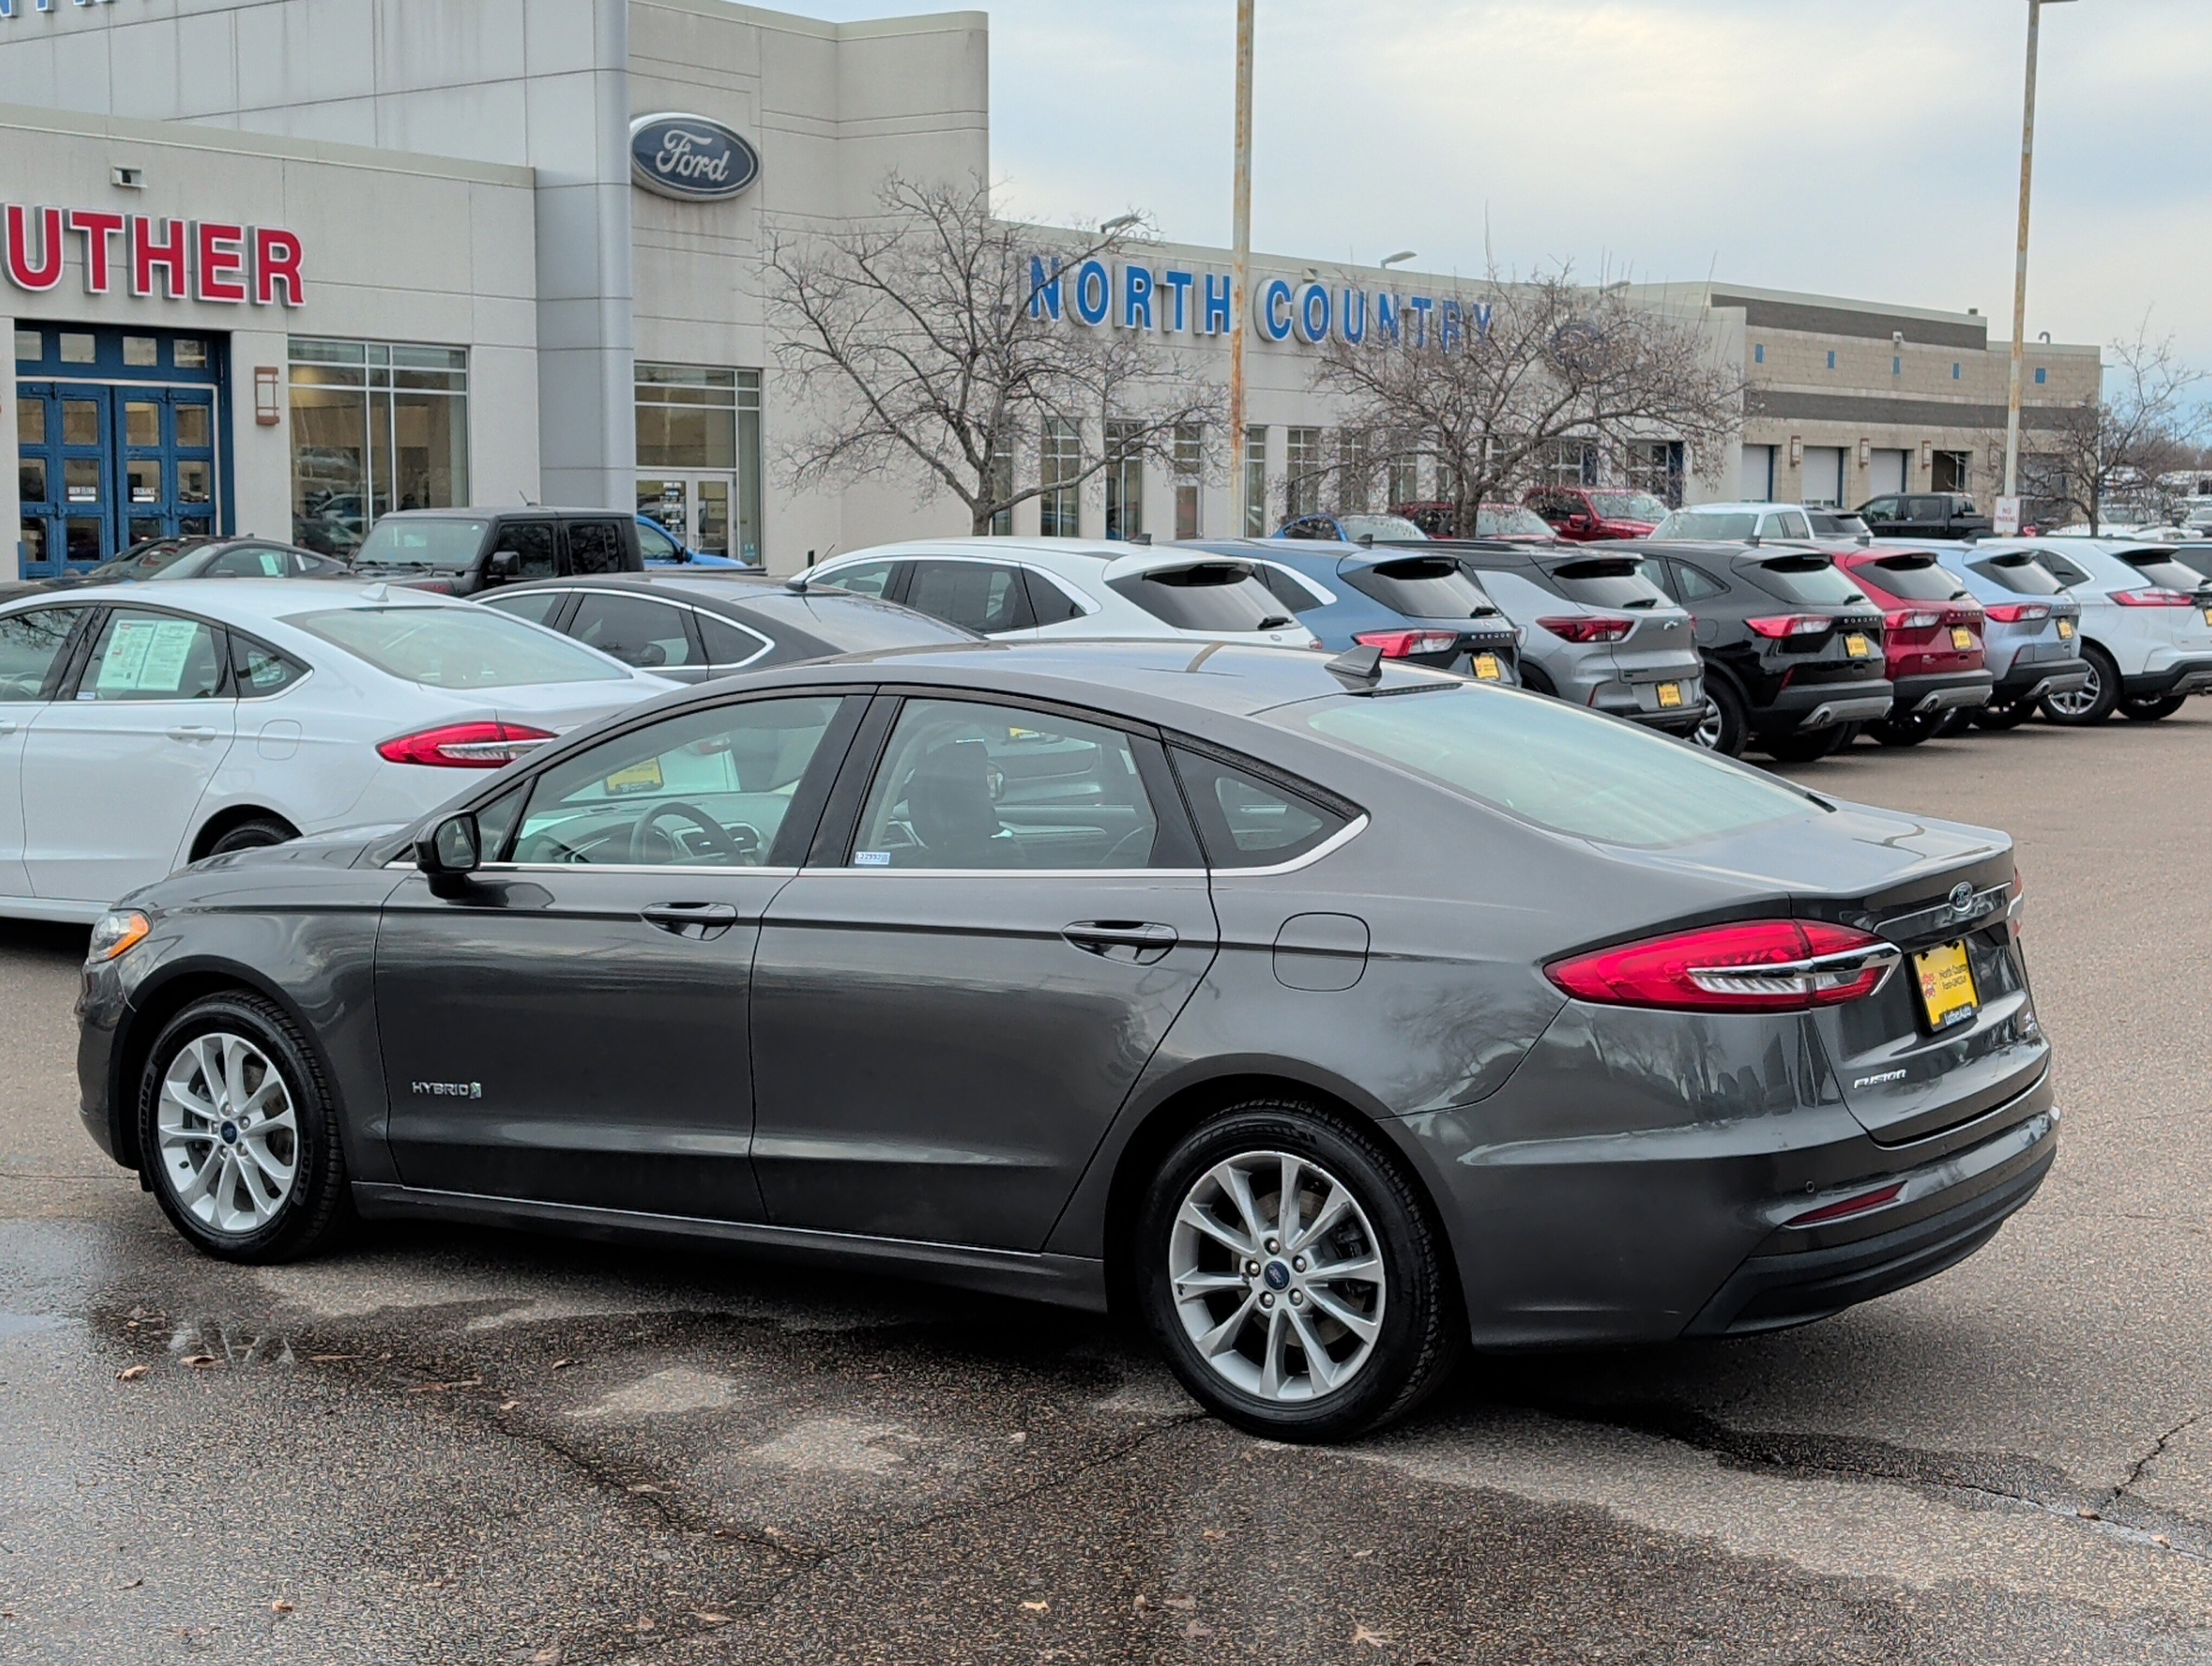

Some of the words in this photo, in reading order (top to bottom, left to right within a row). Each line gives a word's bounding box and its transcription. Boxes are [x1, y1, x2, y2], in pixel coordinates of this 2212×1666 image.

[656, 130, 730, 181] Ford
[2, 202, 305, 307] UTHER
[1029, 255, 1232, 336] NORTH
[1257, 278, 1494, 355] COUNTRY
[412, 1081, 468, 1096] HYBRID
